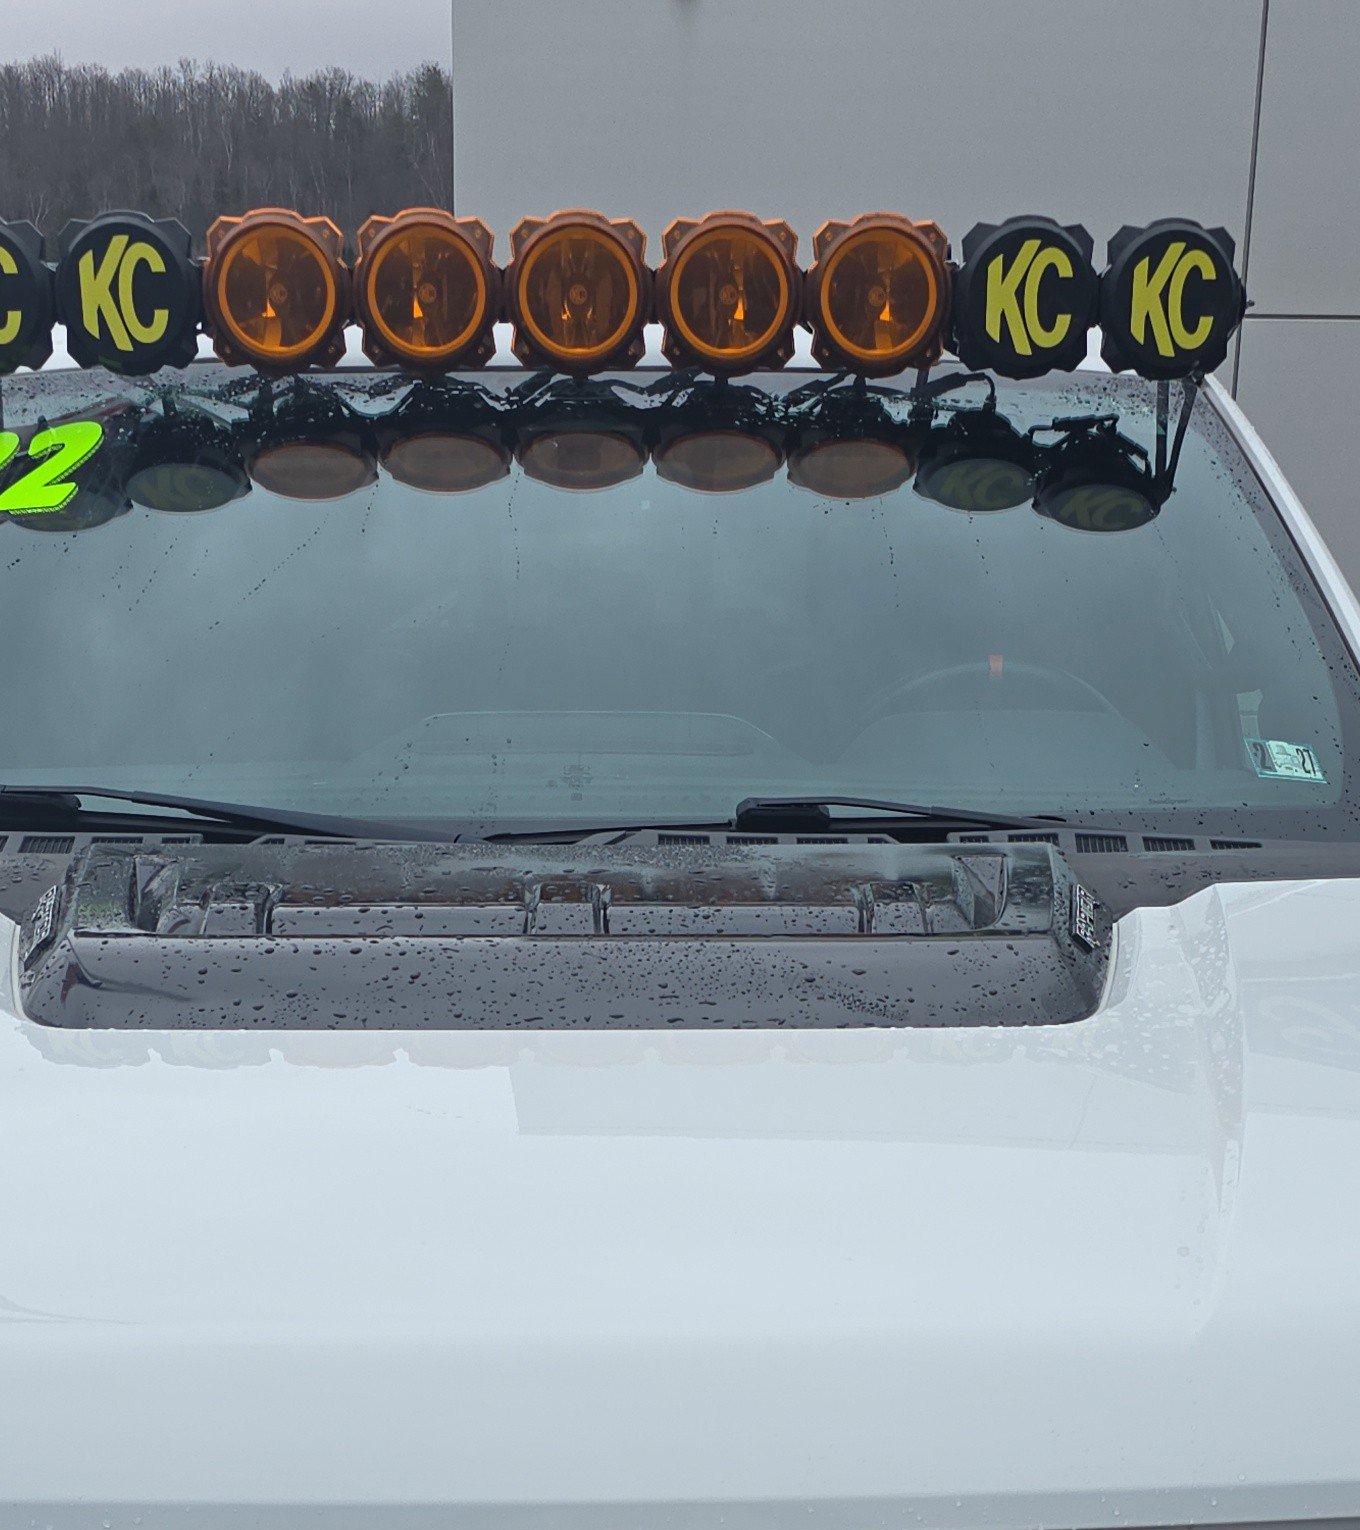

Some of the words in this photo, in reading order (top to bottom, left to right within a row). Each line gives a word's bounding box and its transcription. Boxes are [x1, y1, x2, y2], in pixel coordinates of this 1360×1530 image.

[79, 234, 170, 352] KC
[985, 238, 1074, 357] KC
[1130, 241, 1217, 358] KC
